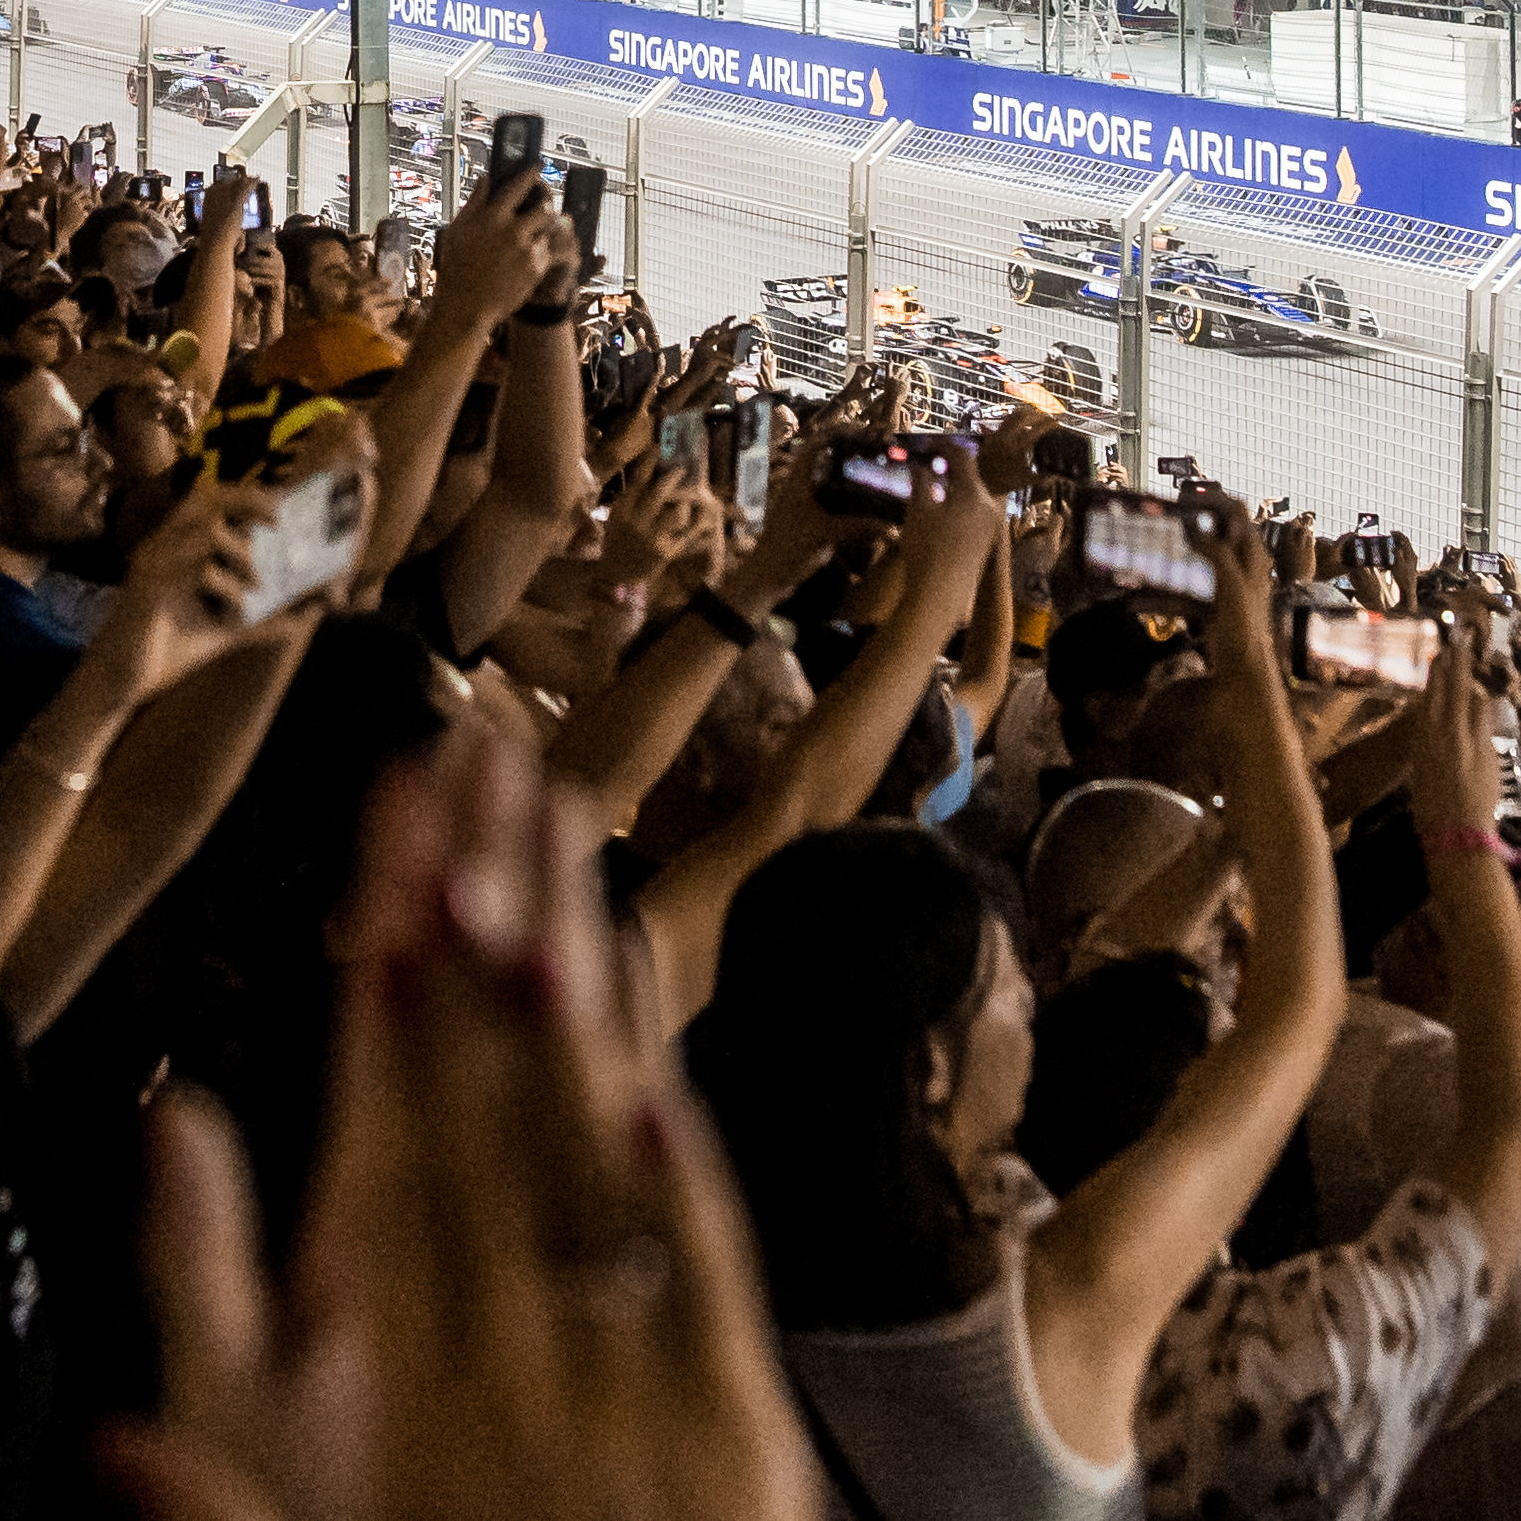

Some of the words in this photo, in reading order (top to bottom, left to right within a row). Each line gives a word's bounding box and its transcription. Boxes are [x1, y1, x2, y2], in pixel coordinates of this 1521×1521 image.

[443, 0, 530, 46] AIRLINES
[608, 28, 740, 86] SINGAPORE
[747, 53, 866, 108] AIRLINES
[972, 91, 1153, 164] SINGAPORE
[1163, 125, 1328, 195] AIRLINES
